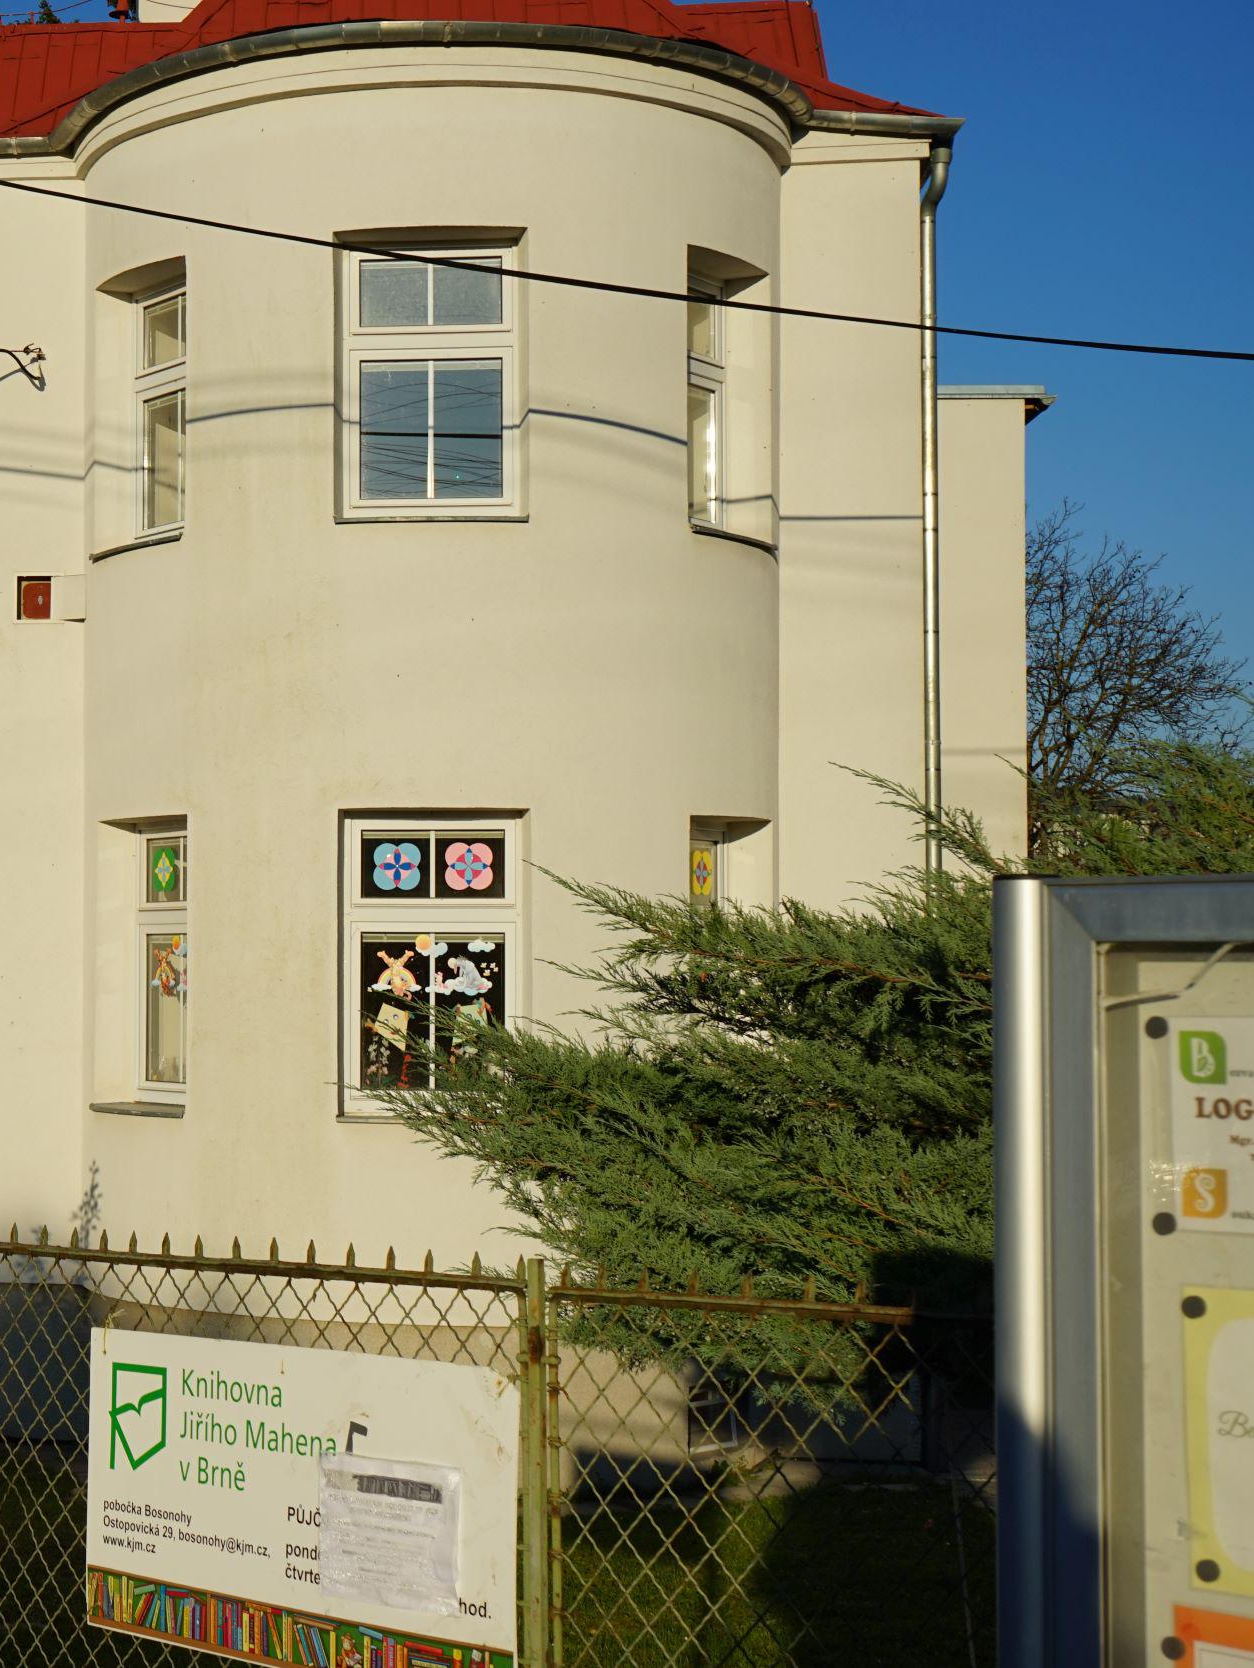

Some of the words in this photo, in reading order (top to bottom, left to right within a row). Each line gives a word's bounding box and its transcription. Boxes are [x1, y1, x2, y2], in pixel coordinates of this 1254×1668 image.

[1194, 1096, 1254, 1121] LOG
[181, 1368, 283, 1409] Knihovna
[179, 1410, 238, 1446] Jiřího
[246, 1419, 338, 1459] Mahena
[179, 1460, 191, 1482] v
[197, 1455, 247, 1492] Brně
[103, 1499, 142, 1516] pobočka
[144, 1503, 192, 1528] Bosonohy
[102, 1514, 160, 1537] Ostopovická
[162, 1524, 176, 1542] 29,
[178, 1527, 271, 1559] bosonohy@kjm.cz,
[102, 1533, 157, 1555] www.kjm.cz
[458, 1596, 493, 1620] hod.
